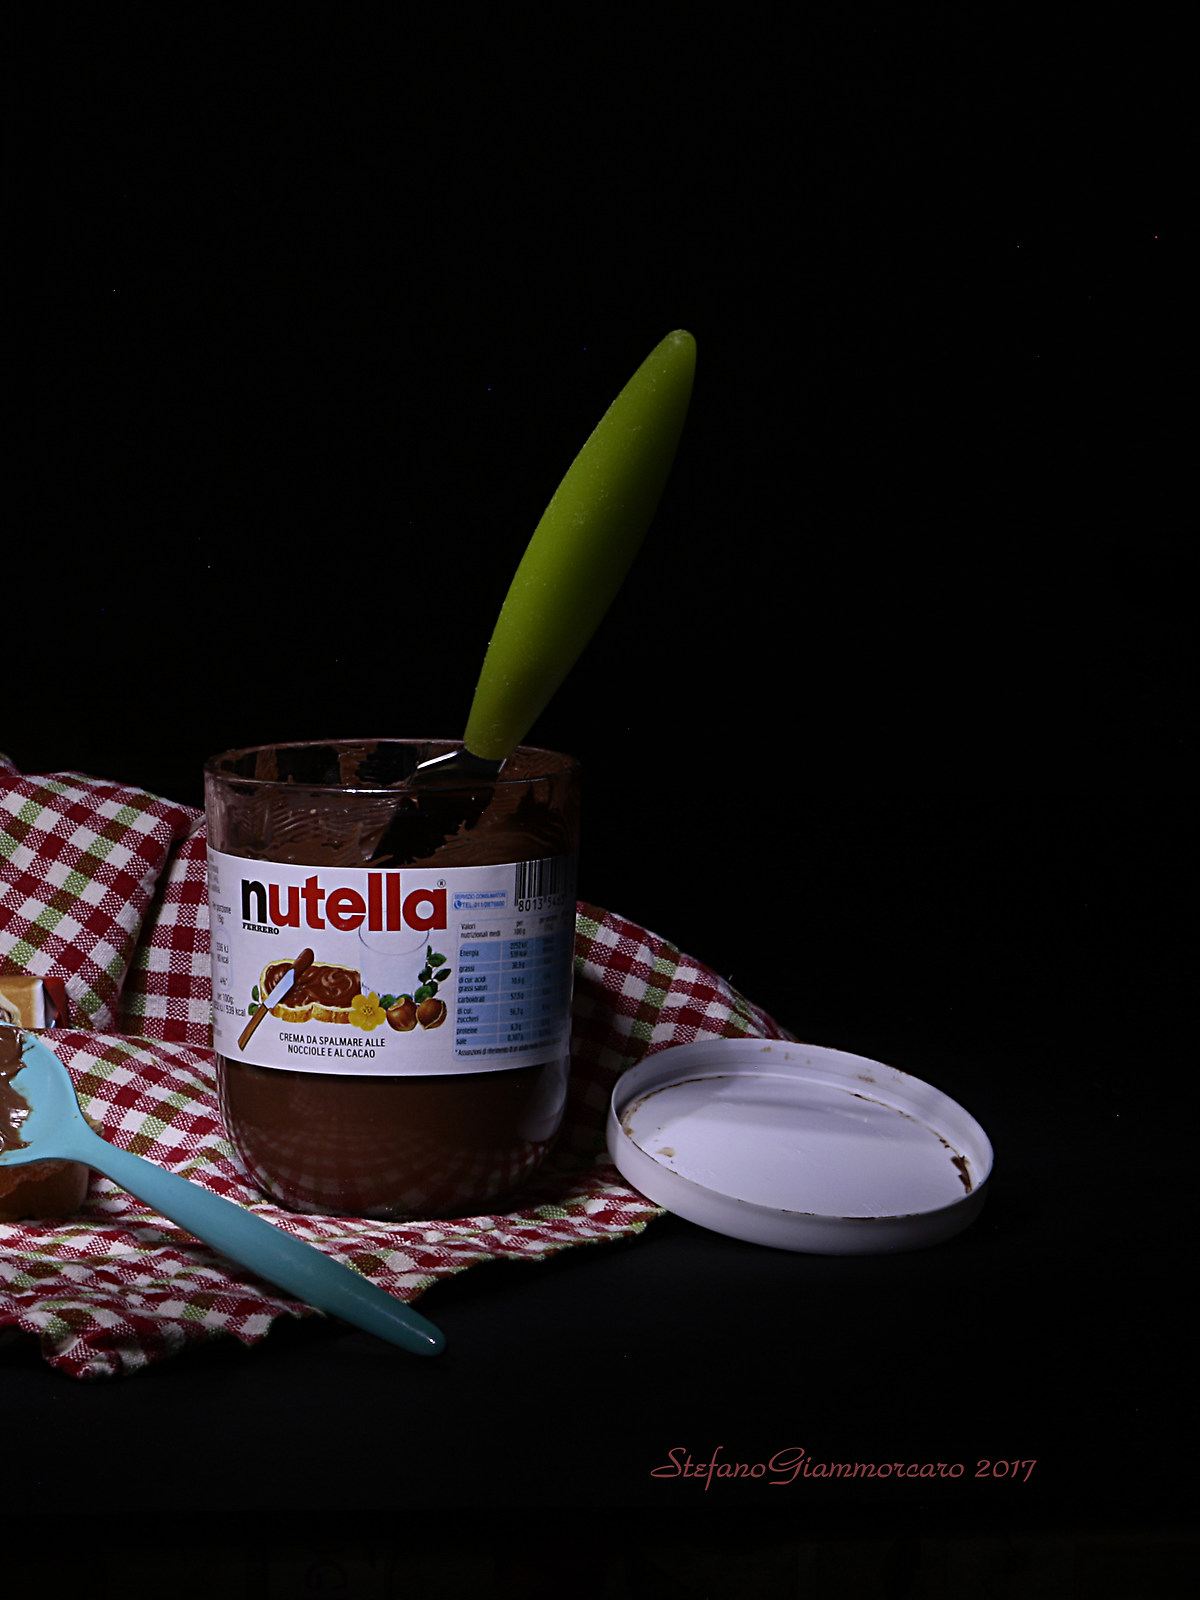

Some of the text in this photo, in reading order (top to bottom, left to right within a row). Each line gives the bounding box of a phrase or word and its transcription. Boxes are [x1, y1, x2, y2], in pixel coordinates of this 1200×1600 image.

[241, 872, 448, 932] nutella
[242, 922, 280, 935] FERRERO
[460, 950, 479, 958] Energia
[279, 1032, 386, 1047] CREMA DA SPALMARE ALLE
[288, 1044, 376, 1058] NOCCIOLE E AL CACAO
